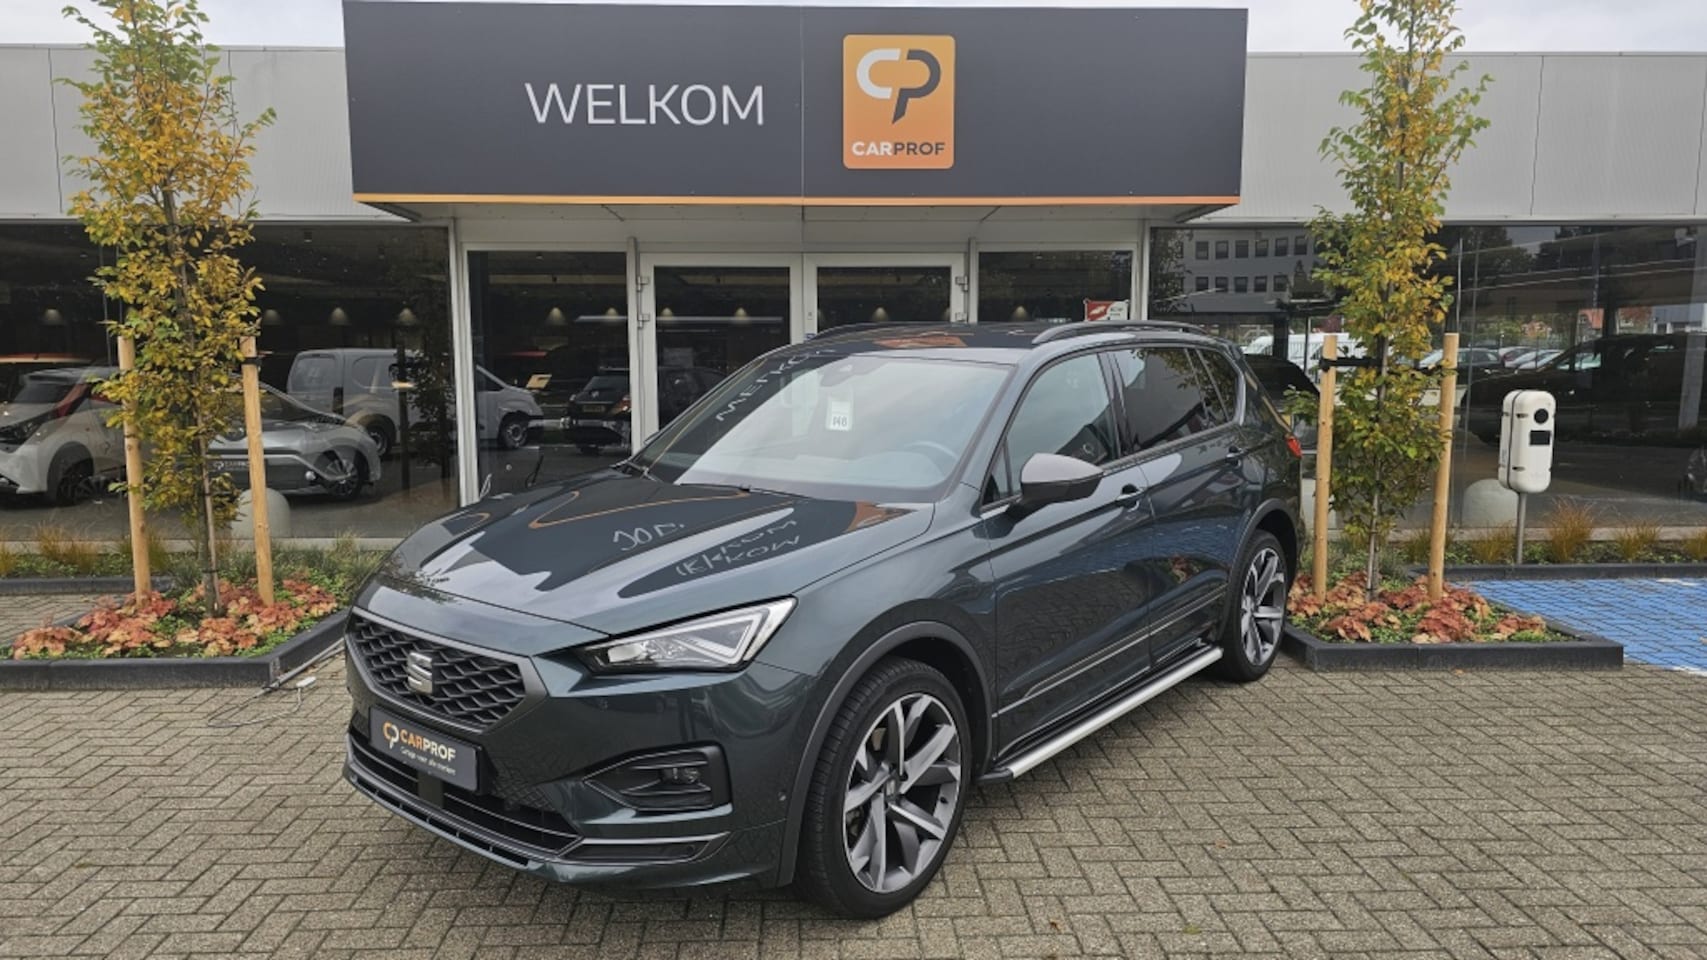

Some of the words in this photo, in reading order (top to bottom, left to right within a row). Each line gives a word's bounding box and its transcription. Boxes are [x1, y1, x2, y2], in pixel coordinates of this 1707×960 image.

[525, 83, 764, 126] WELKOM
[852, 142, 945, 156] CARPROF
[400, 729, 456, 762] CARPROF
